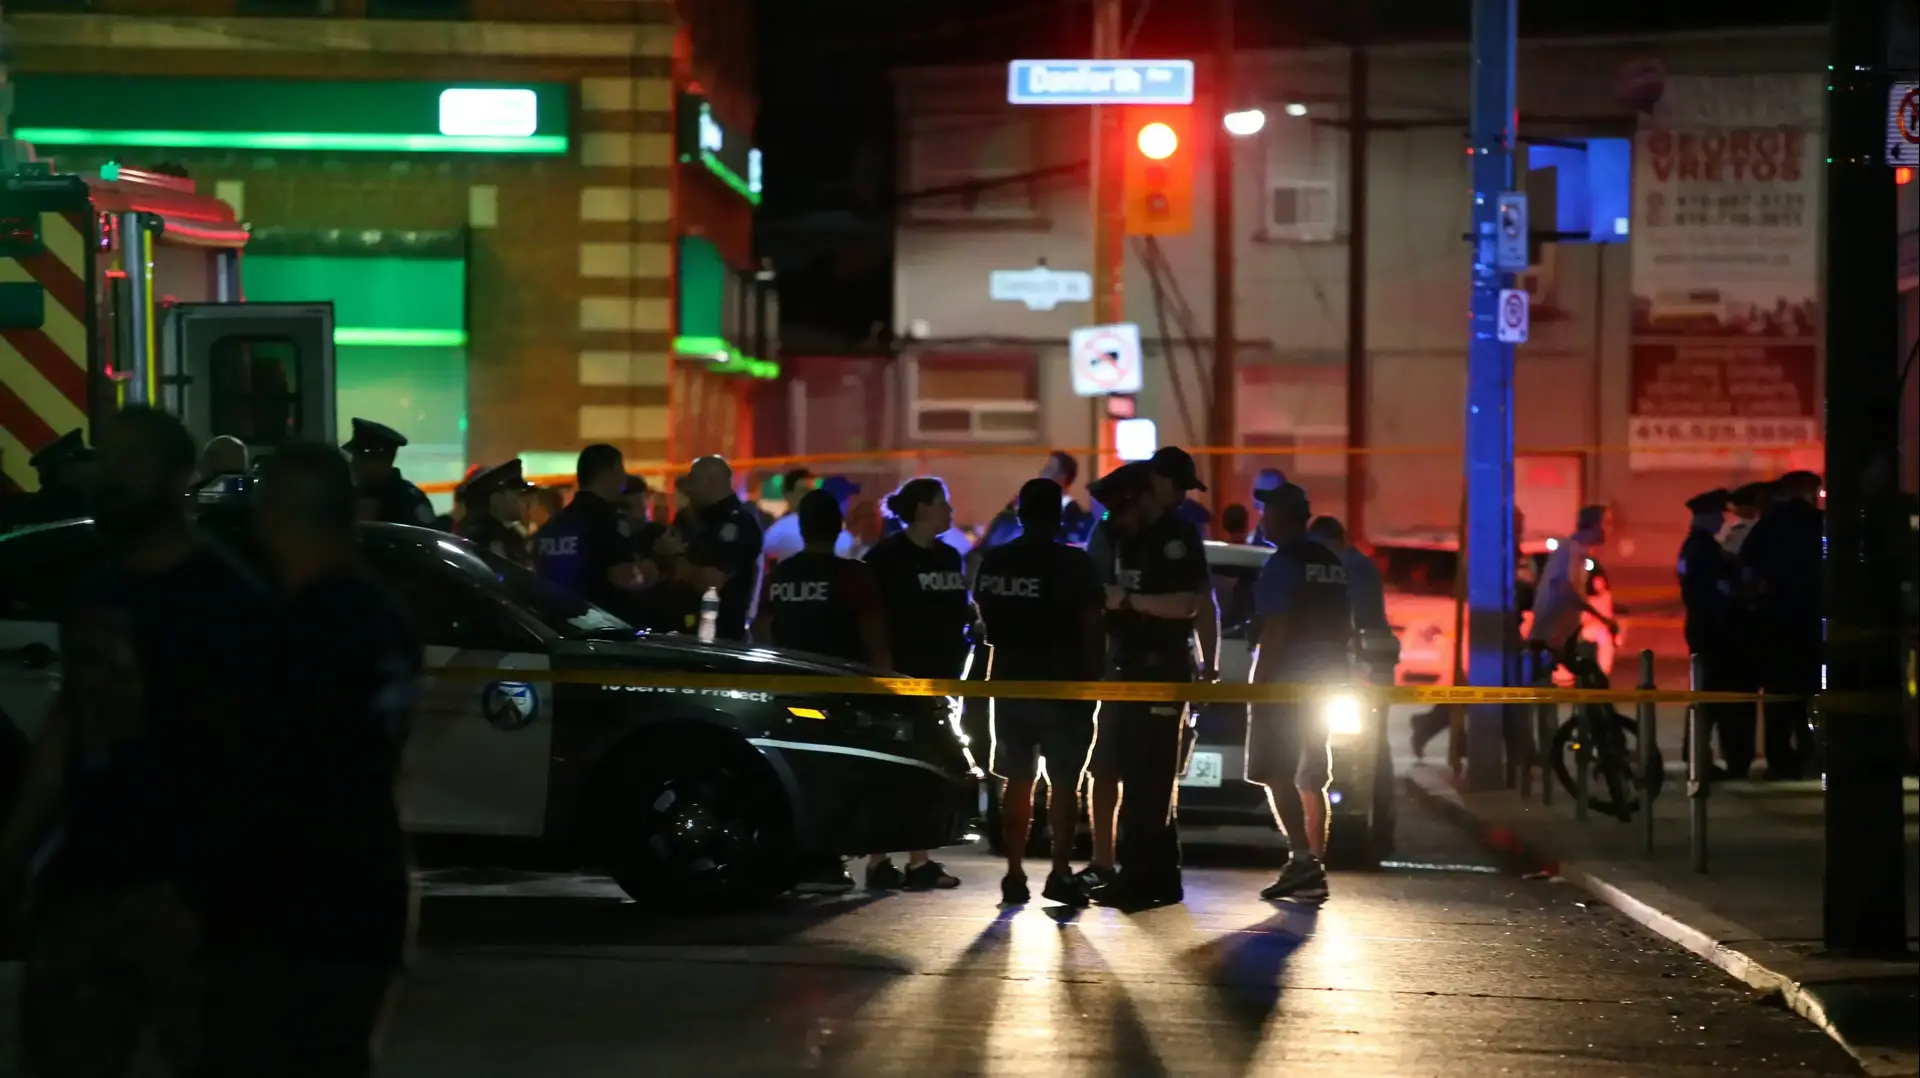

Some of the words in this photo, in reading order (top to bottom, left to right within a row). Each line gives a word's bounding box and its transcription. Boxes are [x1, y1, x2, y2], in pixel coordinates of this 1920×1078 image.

[1648, 129, 1804, 157] GEORGE
[539, 536, 578, 556] POLICE
[918, 572, 966, 591] POLICE
[1305, 563, 1348, 584] POLICE
[769, 581, 830, 602] POLICE
[979, 574, 1041, 598] POLICE
[700, 689, 768, 703] Protect
